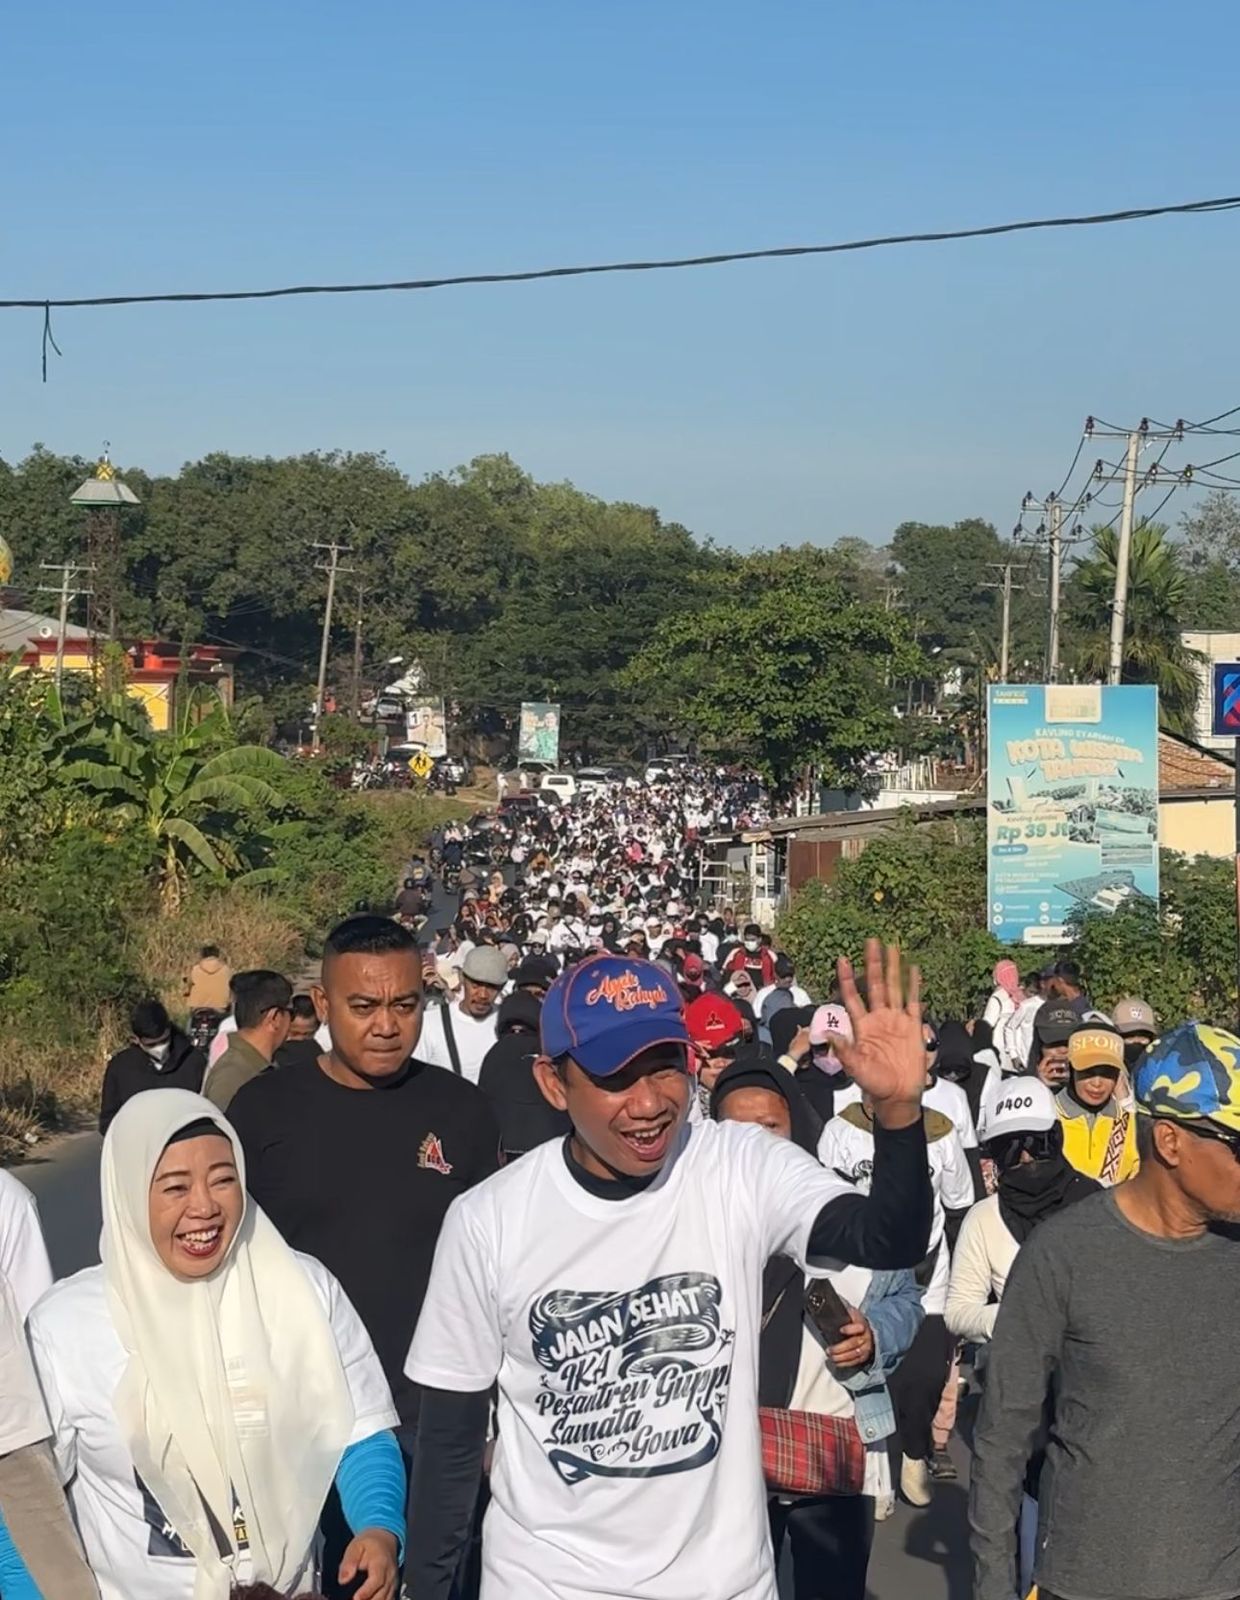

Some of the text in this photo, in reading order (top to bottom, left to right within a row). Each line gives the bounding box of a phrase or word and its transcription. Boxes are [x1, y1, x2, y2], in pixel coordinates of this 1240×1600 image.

[997, 825, 1021, 844] Rp
[1025, 823, 1046, 839] 39
[827, 1012, 840, 1028] LA
[550, 1286, 701, 1361] JALAN SEHAT
[560, 1347, 612, 1392] IKA
[535, 1378, 651, 1416] Pesantren
[542, 1403, 644, 1446] Samata
[629, 1421, 704, 1463] Gowa
